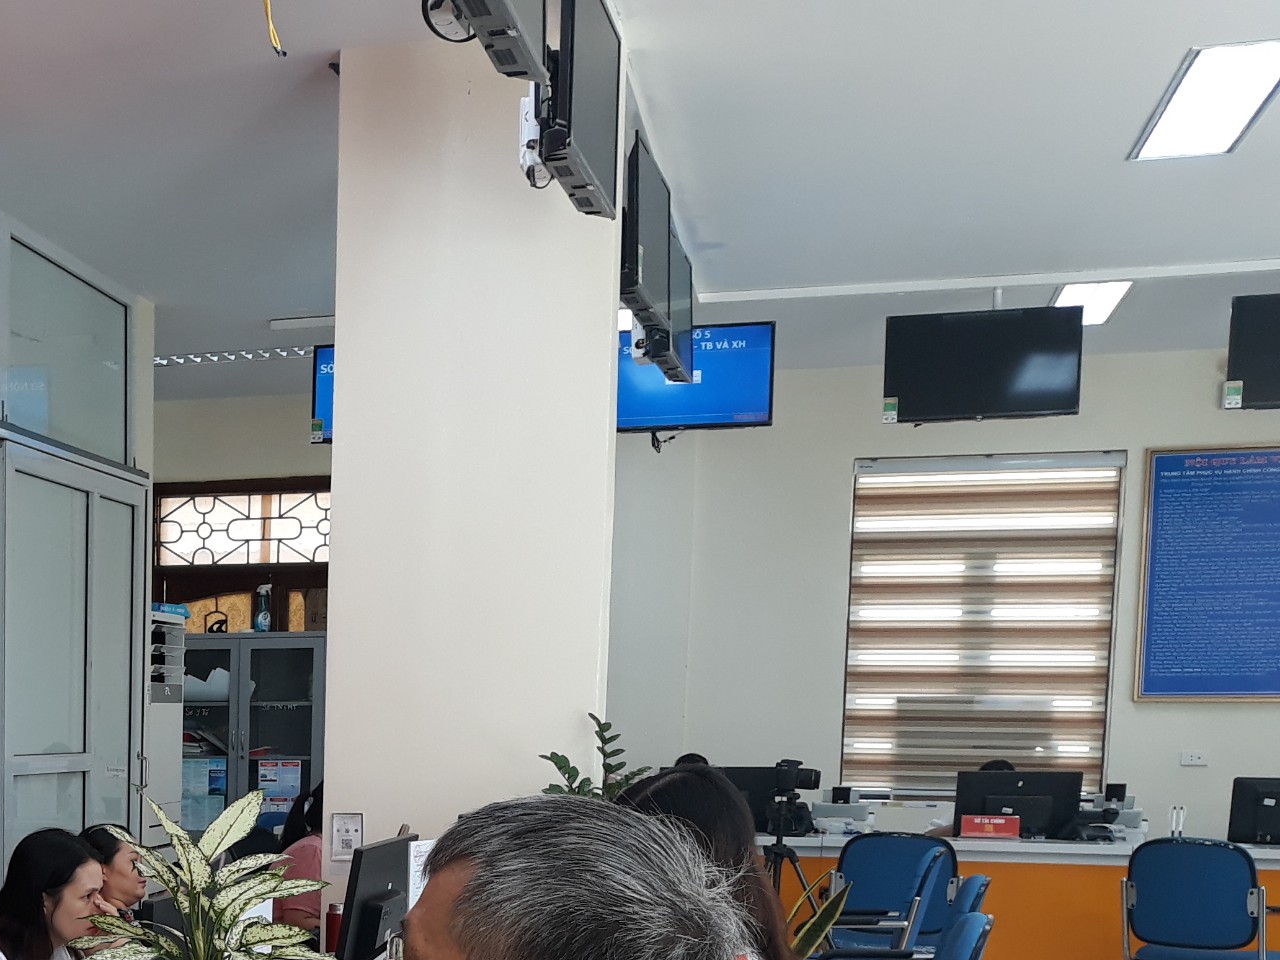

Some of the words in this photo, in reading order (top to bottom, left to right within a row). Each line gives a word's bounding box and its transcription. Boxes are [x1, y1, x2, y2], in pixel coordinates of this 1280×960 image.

[700, 341, 714, 351] TB
[715, 338, 729, 350] VÀ
[731, 340, 746, 349] XH
